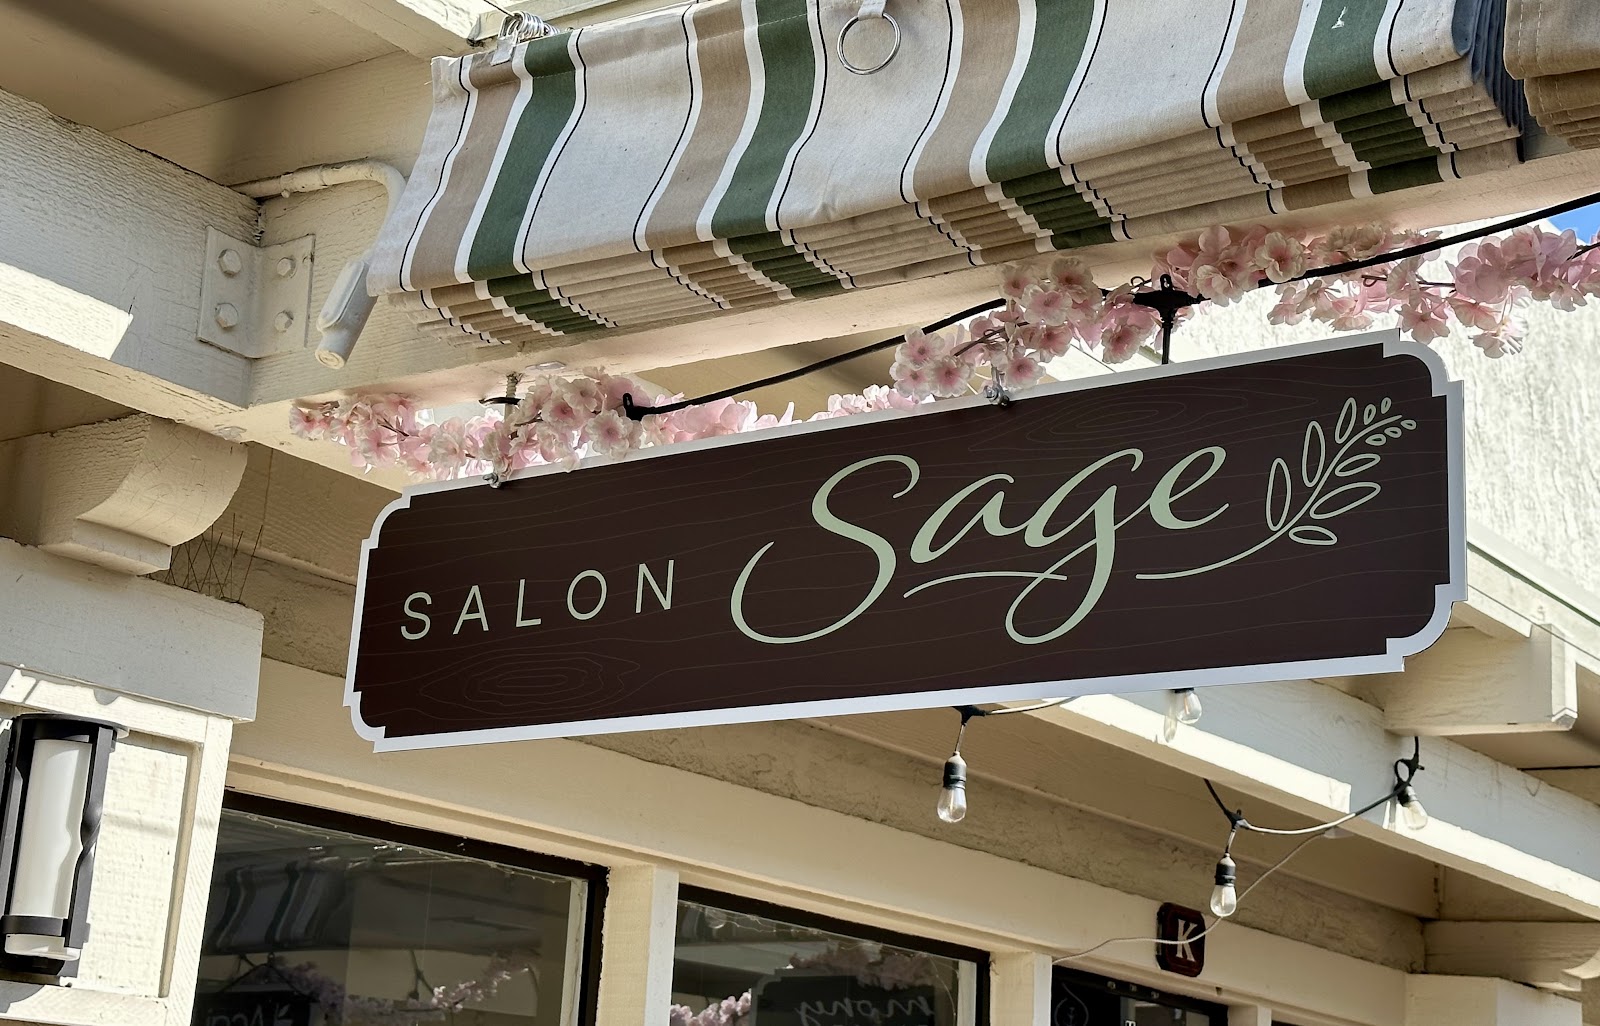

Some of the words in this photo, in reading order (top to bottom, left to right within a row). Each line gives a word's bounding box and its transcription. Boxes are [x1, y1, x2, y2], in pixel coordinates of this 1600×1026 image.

[400, 559, 676, 641] SALON
[731, 446, 1229, 645] Sage
[1175, 918, 1198, 963] K
